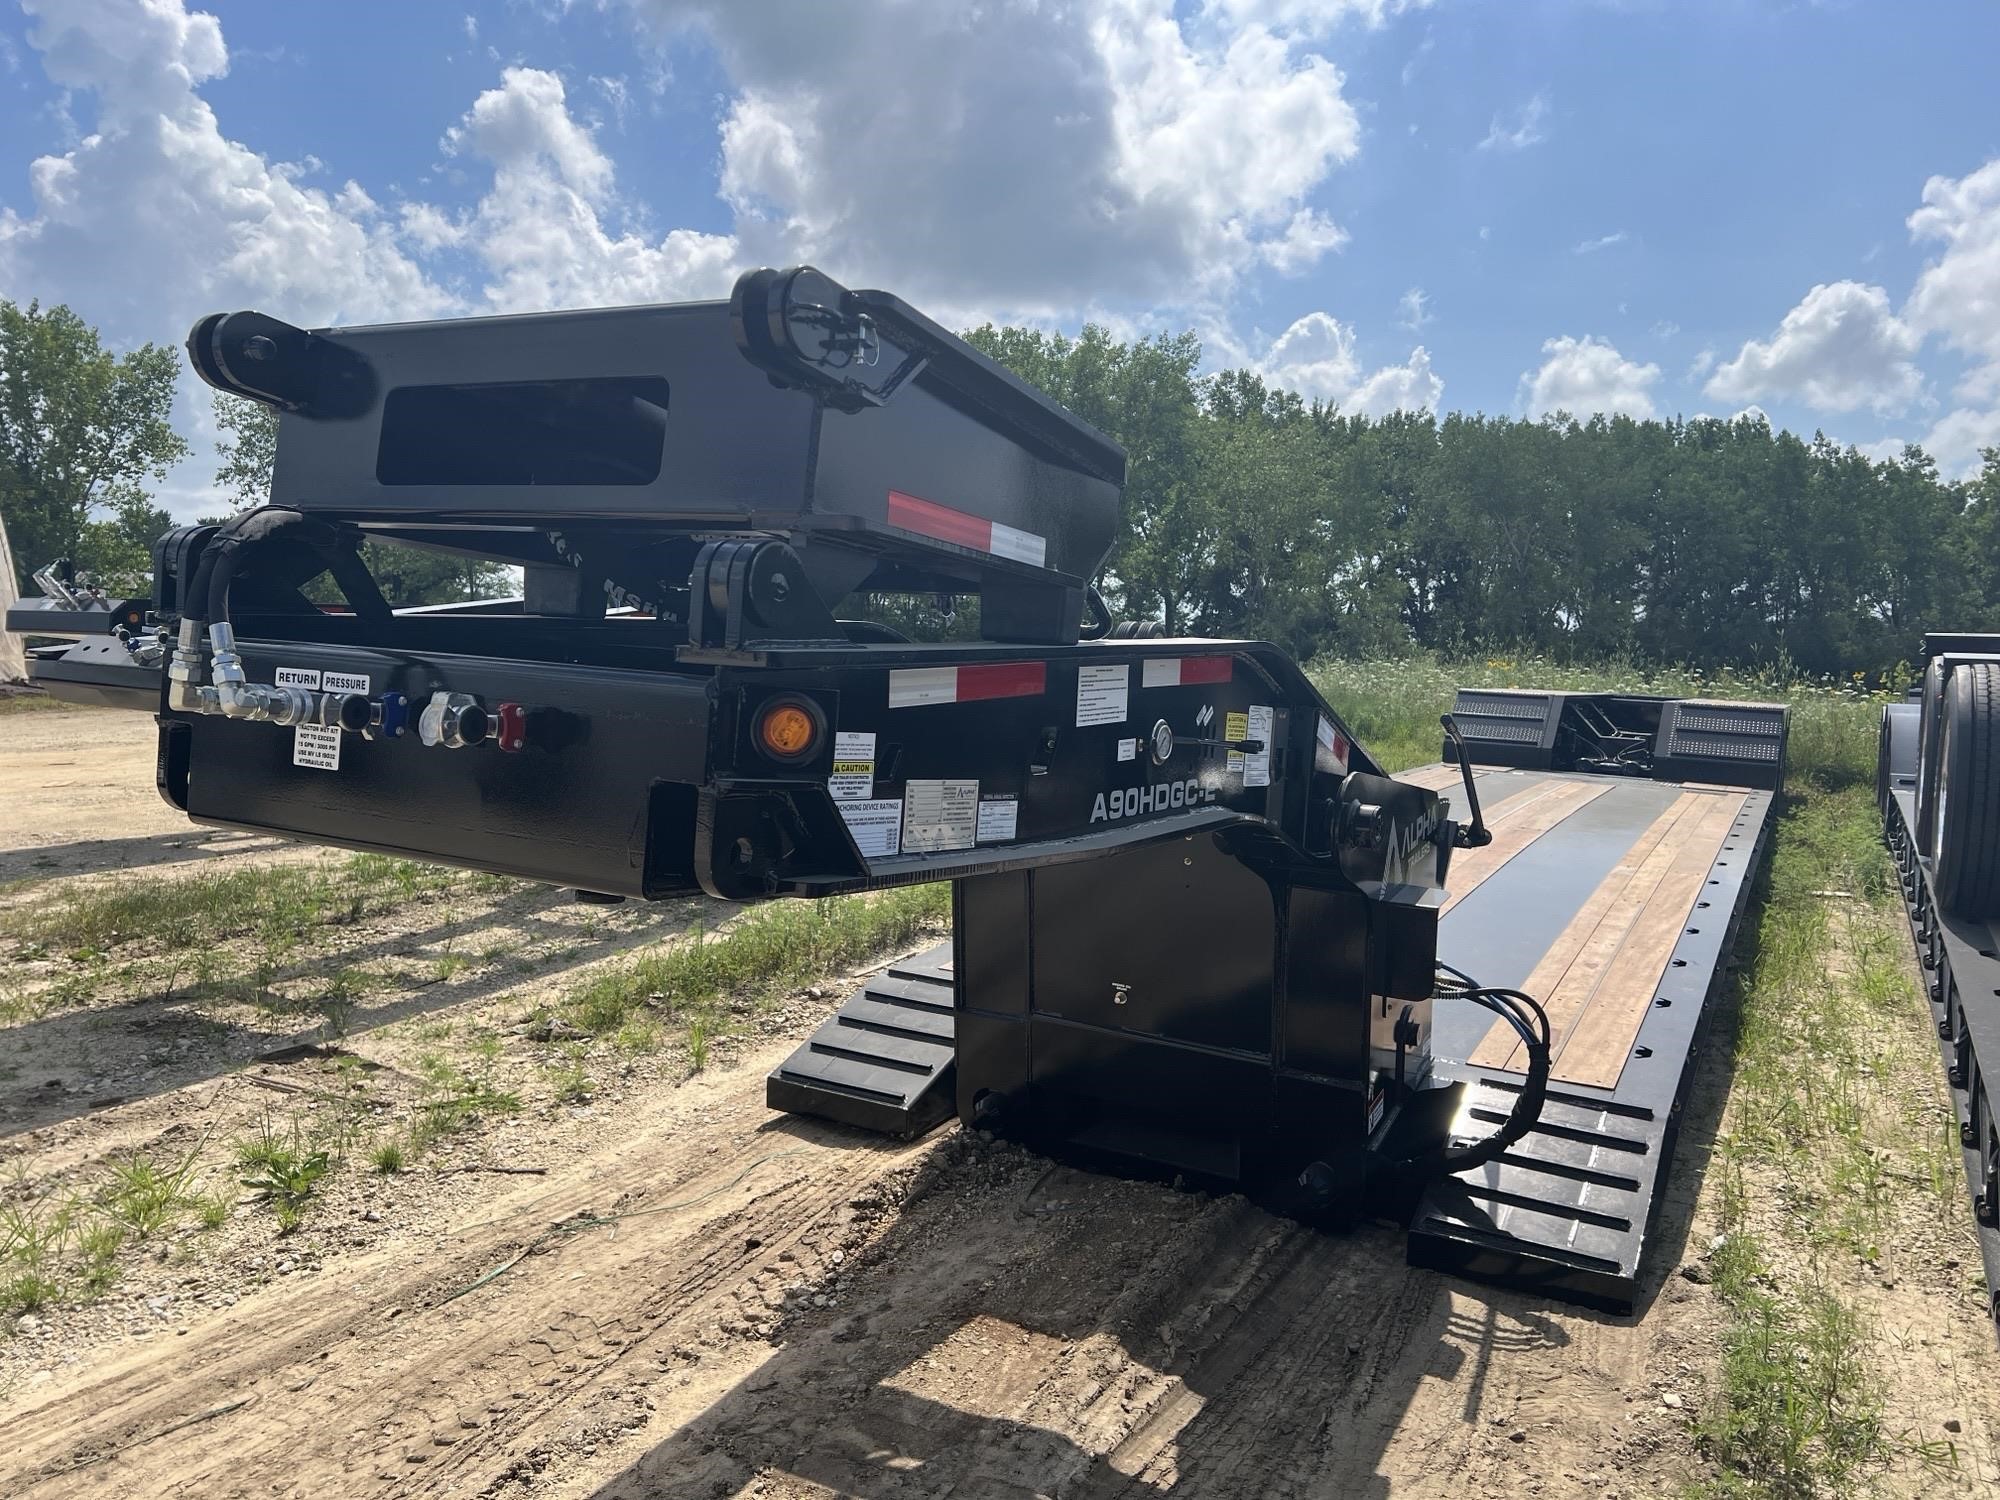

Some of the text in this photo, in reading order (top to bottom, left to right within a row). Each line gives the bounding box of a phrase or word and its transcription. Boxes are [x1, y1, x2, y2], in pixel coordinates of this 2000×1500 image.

[278, 672, 318, 685] RETURN
[325, 676, 366, 690] PRESSURE
[299, 758, 324, 766] HYDRAULIC
[840, 764, 870, 772] CAUTION
[863, 803, 879, 811] DEVICE
[880, 802, 899, 810] RATINGS
[1402, 804, 1437, 858] ALPHA
